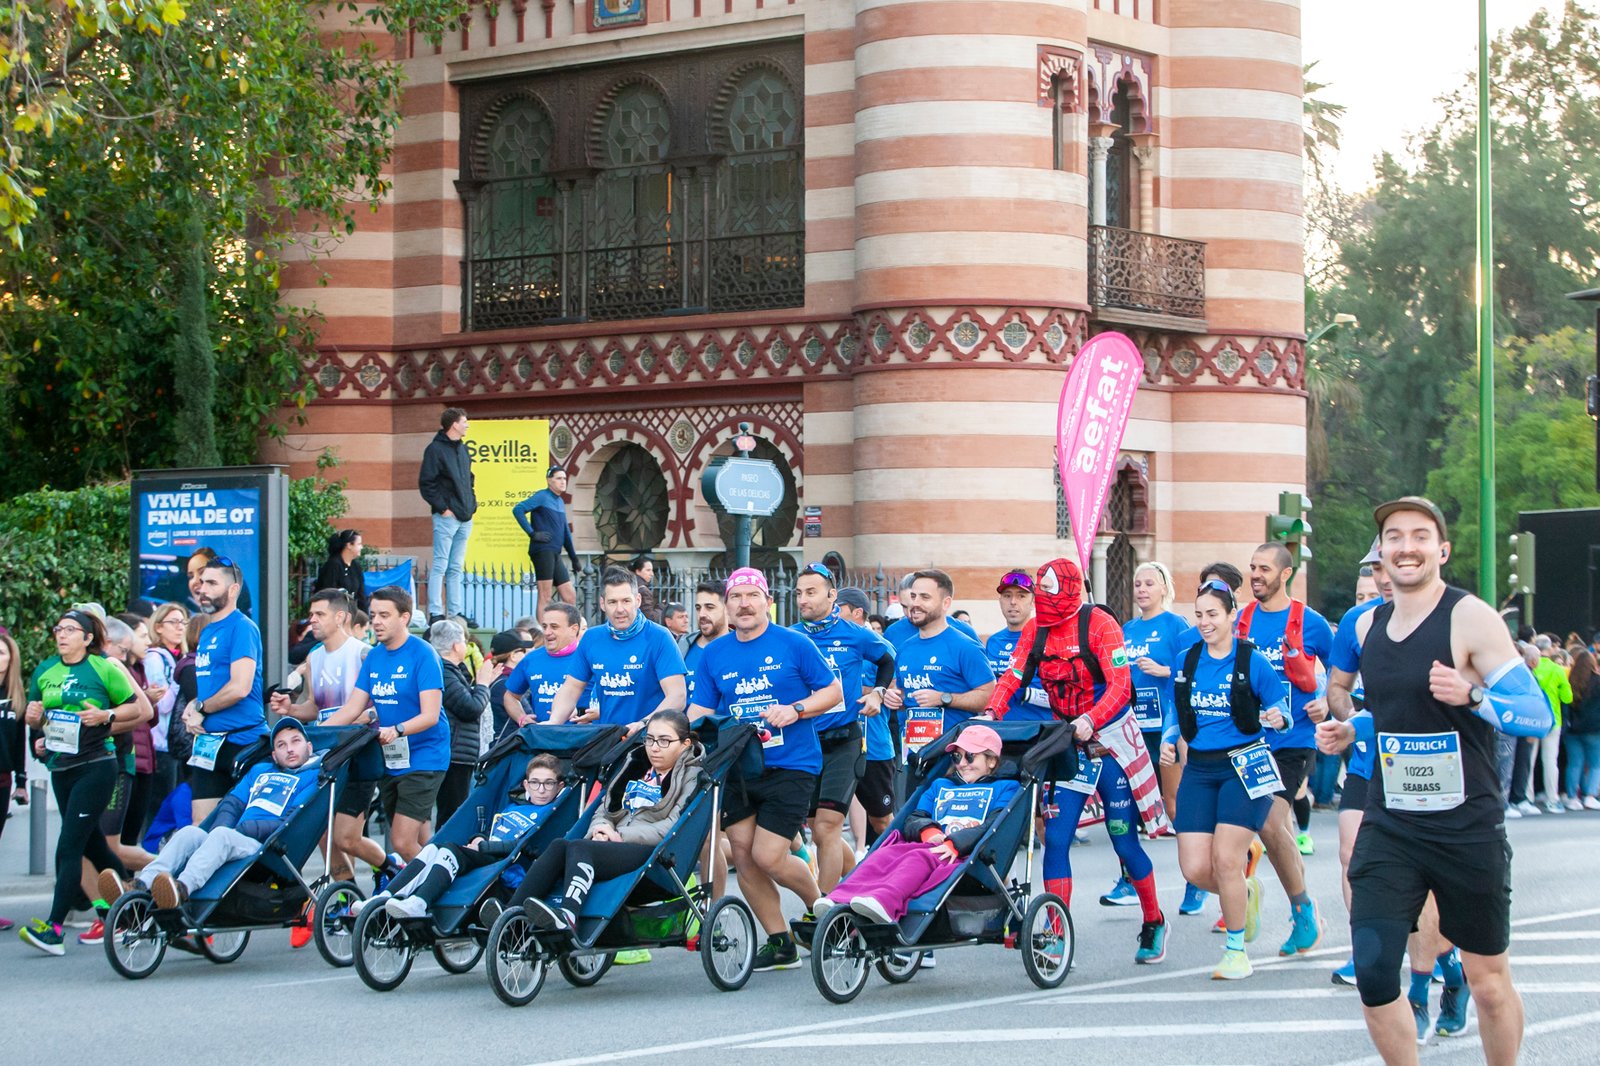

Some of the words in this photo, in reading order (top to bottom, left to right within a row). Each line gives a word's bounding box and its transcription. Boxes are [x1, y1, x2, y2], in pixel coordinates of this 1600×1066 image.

[1075, 355, 1123, 474] aefat
[465, 439, 538, 458] Sevilla.
[1105, 430, 1121, 471] BIZUM
[741, 473, 759, 483] PASEO
[729, 487, 737, 497] DE
[738, 488, 748, 497] LAS
[748, 489, 771, 500] DELICIAS
[147, 493, 191, 509] VIVE
[193, 492, 217, 507] LA
[148, 510, 202, 525] FINAL
[204, 509, 227, 524] DE
[230, 508, 255, 523] OT
[759, 664, 781, 672] ZURICH
[52, 712, 76, 721] ZURICH
[1514, 716, 1542, 728] ZURICH
[1403, 740, 1447, 751] ZURICH
[1404, 766, 1434, 777] 10223
[269, 775, 291, 785] ZURICH
[637, 783, 661, 795] ZURIC
[1402, 782, 1441, 792] SEABASS
[957, 790, 985, 798] ZURICH
[509, 812, 529, 829] ZURICH
[565, 862, 595, 905] FILA
